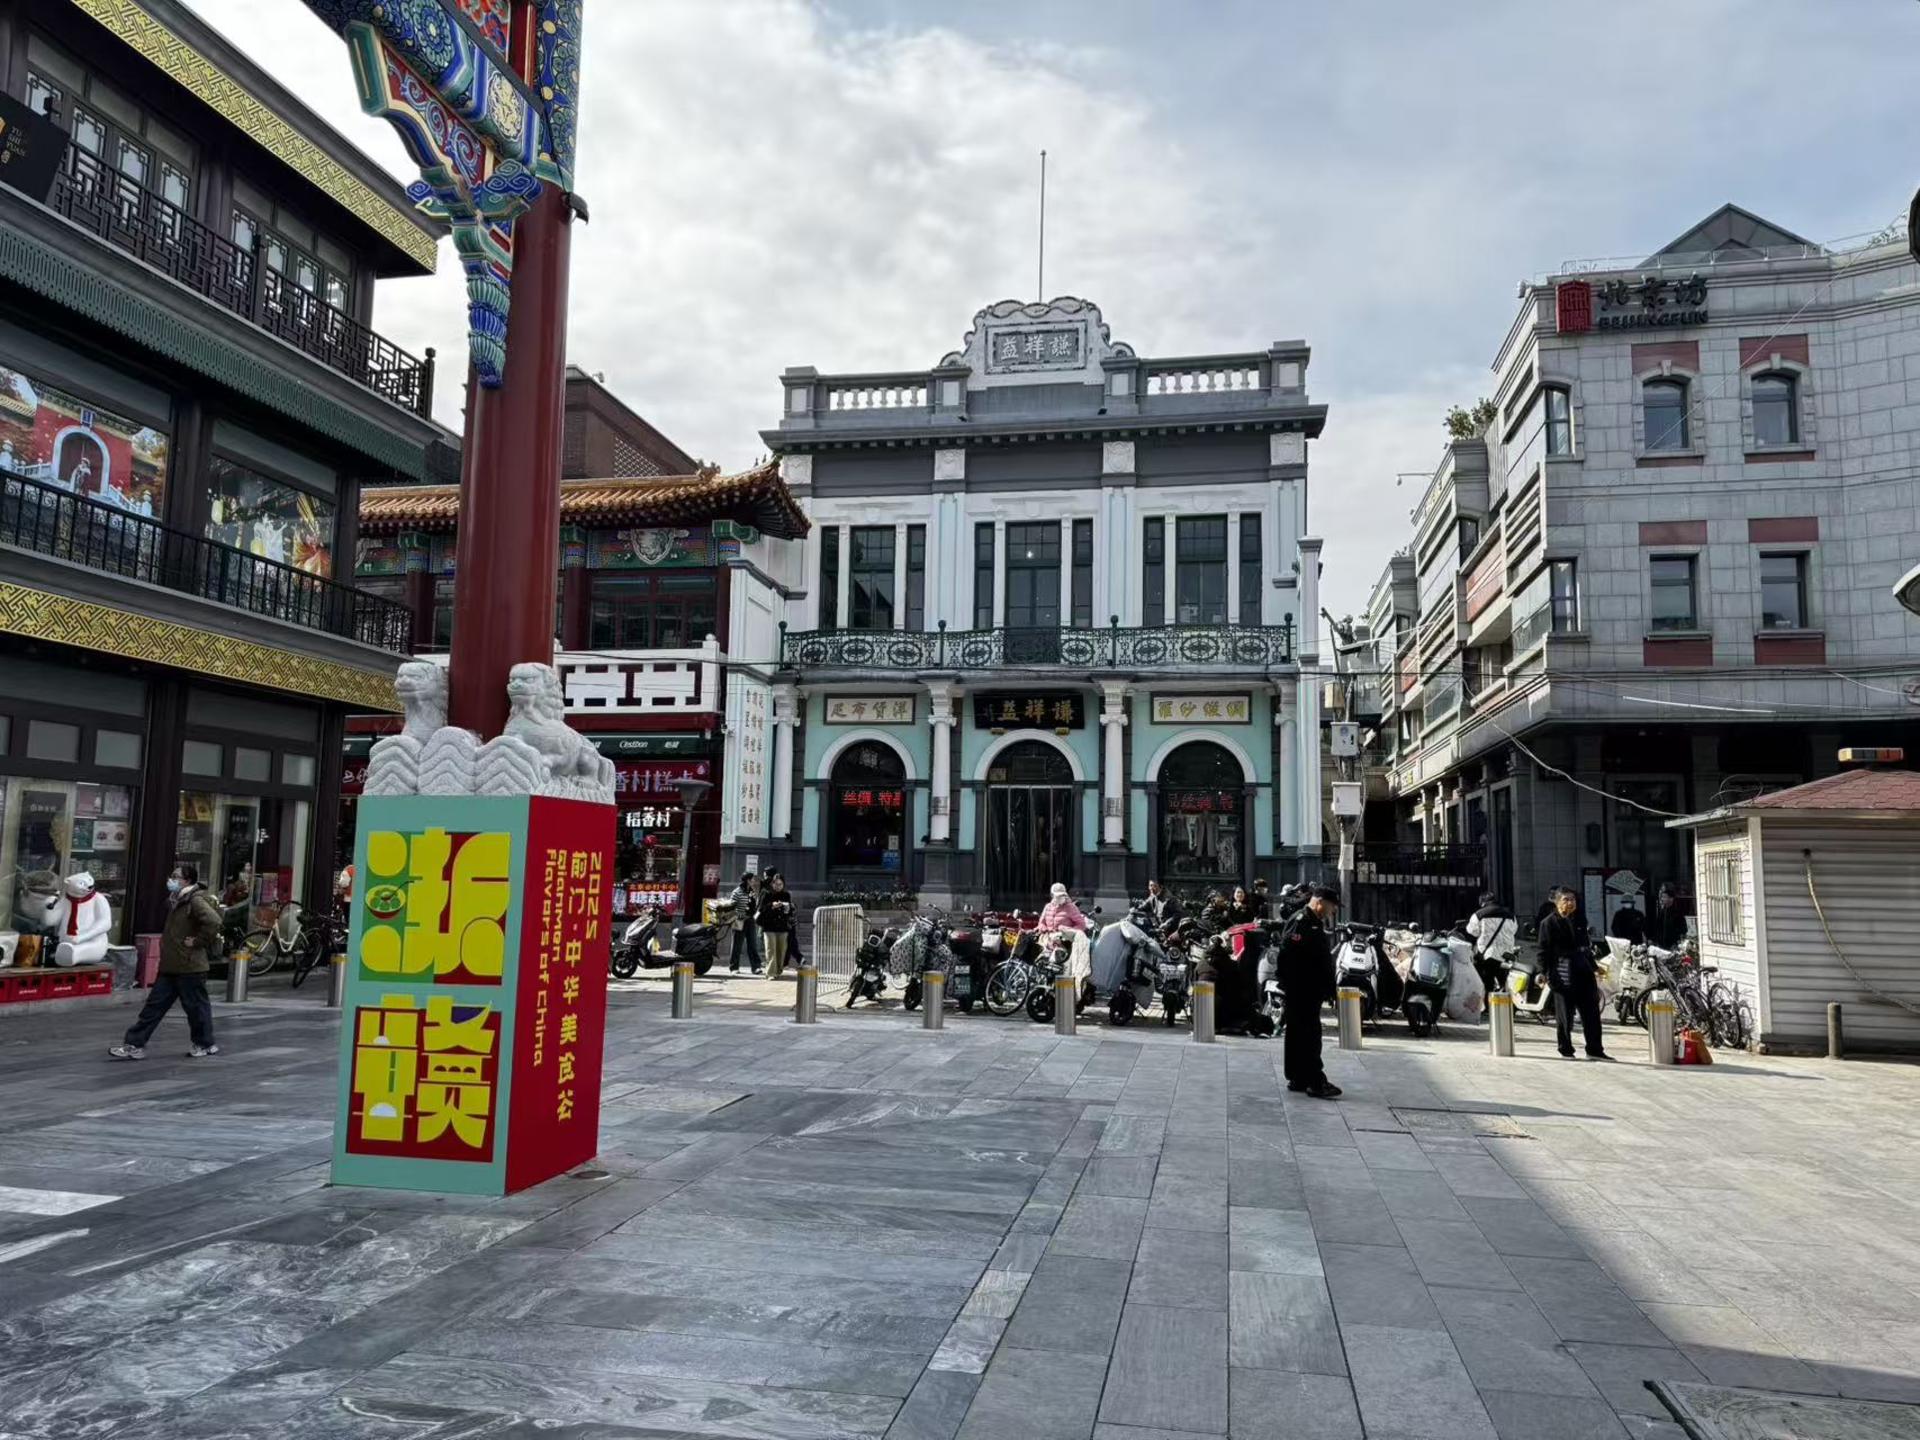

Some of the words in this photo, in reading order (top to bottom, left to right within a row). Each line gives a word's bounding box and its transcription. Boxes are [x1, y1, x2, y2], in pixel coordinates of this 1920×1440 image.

[1598, 275, 1708, 311] 北京坊
[626, 811, 671, 828] 稻香村
[541, 849, 557, 946] Flavors
[552, 850, 567, 962] Qianmen
[586, 851, 602, 940] 2025
[539, 953, 549, 984] of
[534, 990, 547, 1067] China
